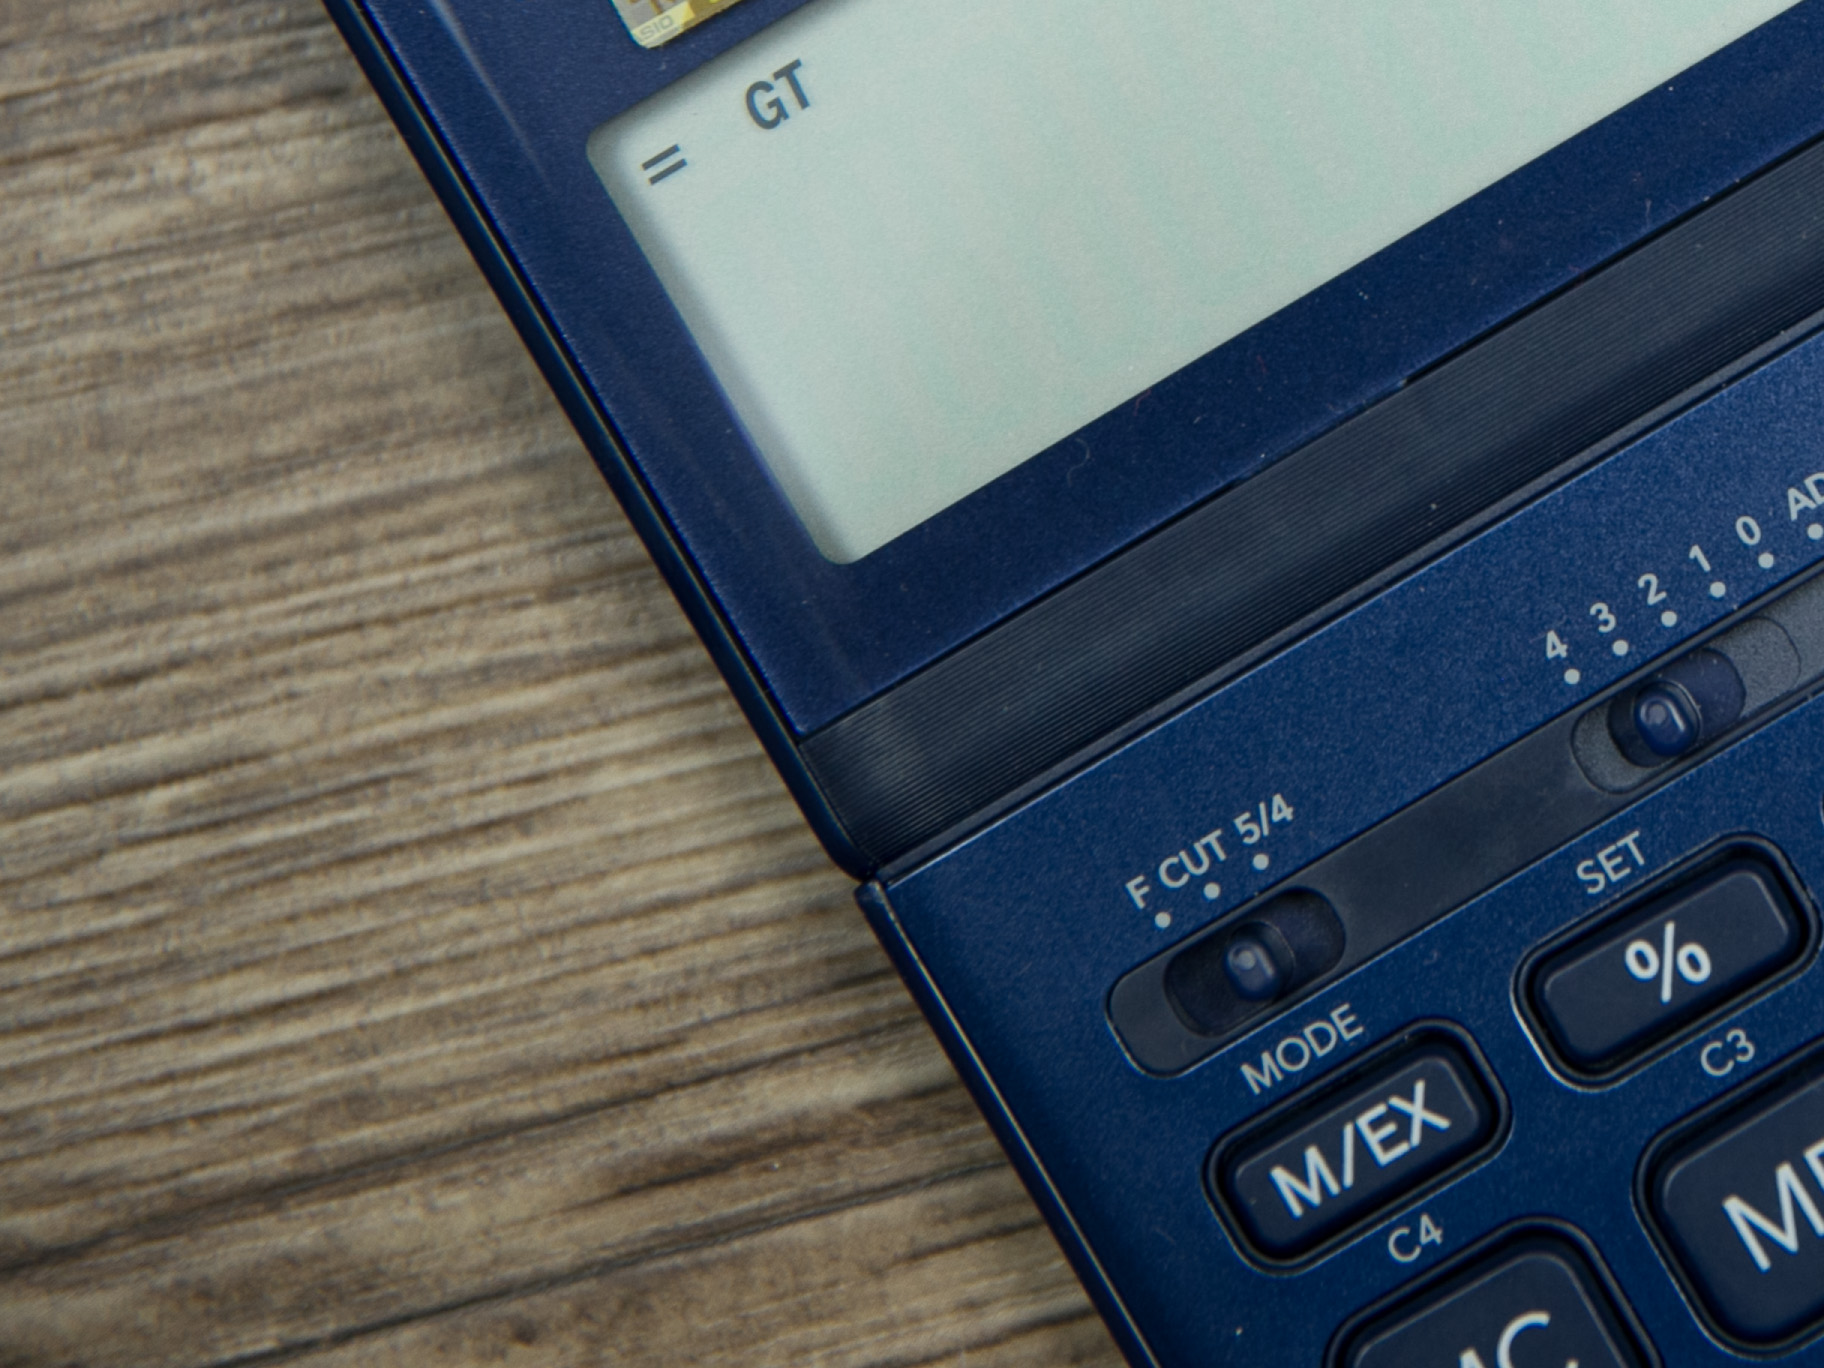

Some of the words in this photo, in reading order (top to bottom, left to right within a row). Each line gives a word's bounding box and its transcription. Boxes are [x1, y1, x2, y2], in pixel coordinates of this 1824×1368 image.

[639, 15, 674, 41] SIO
[746, 59, 812, 130] GT
[1547, 630, 1567, 658] 4
[1590, 603, 1616, 632] 3
[1638, 574, 1666, 605] 2
[1689, 545, 1710, 571] 1
[1736, 516, 1761, 545] 0
[1126, 875, 1149, 909] F
[1158, 831, 1229, 893] CUT
[1234, 794, 1293, 844] 5/4
[1577, 831, 1644, 894] SET
[1626, 922, 1711, 1002] %
[1241, 1003, 1364, 1095] MODE
[1701, 1029, 1755, 1076] C3
[1268, 1079, 1451, 1219] M/EX
[1388, 1214, 1442, 1262] C4
[1461, 1312, 1578, 1368] C
